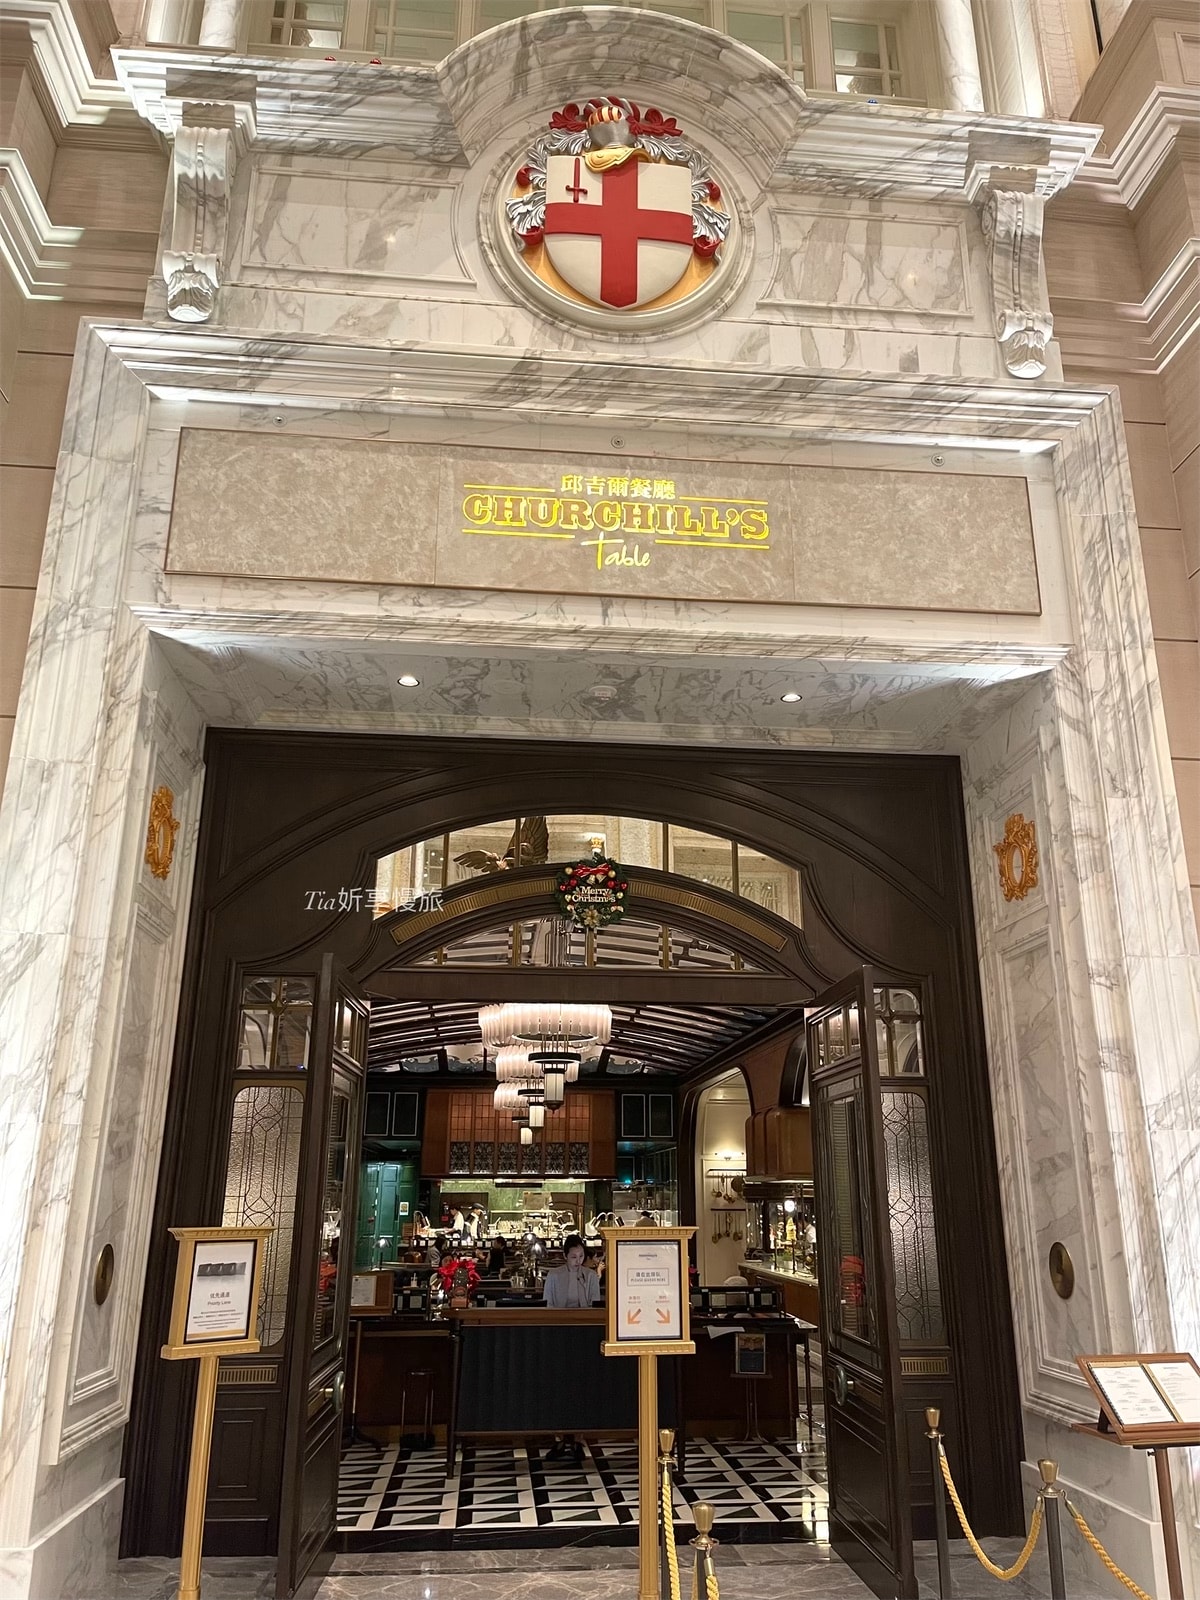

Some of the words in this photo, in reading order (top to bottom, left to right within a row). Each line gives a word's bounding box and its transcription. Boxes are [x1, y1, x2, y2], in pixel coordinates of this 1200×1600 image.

[561, 474, 676, 500] 邱吉爾餐廳
[463, 494, 770, 540] CHURCHILL'S
[581, 531, 651, 570] Table
[580, 886, 610, 897] Merry
